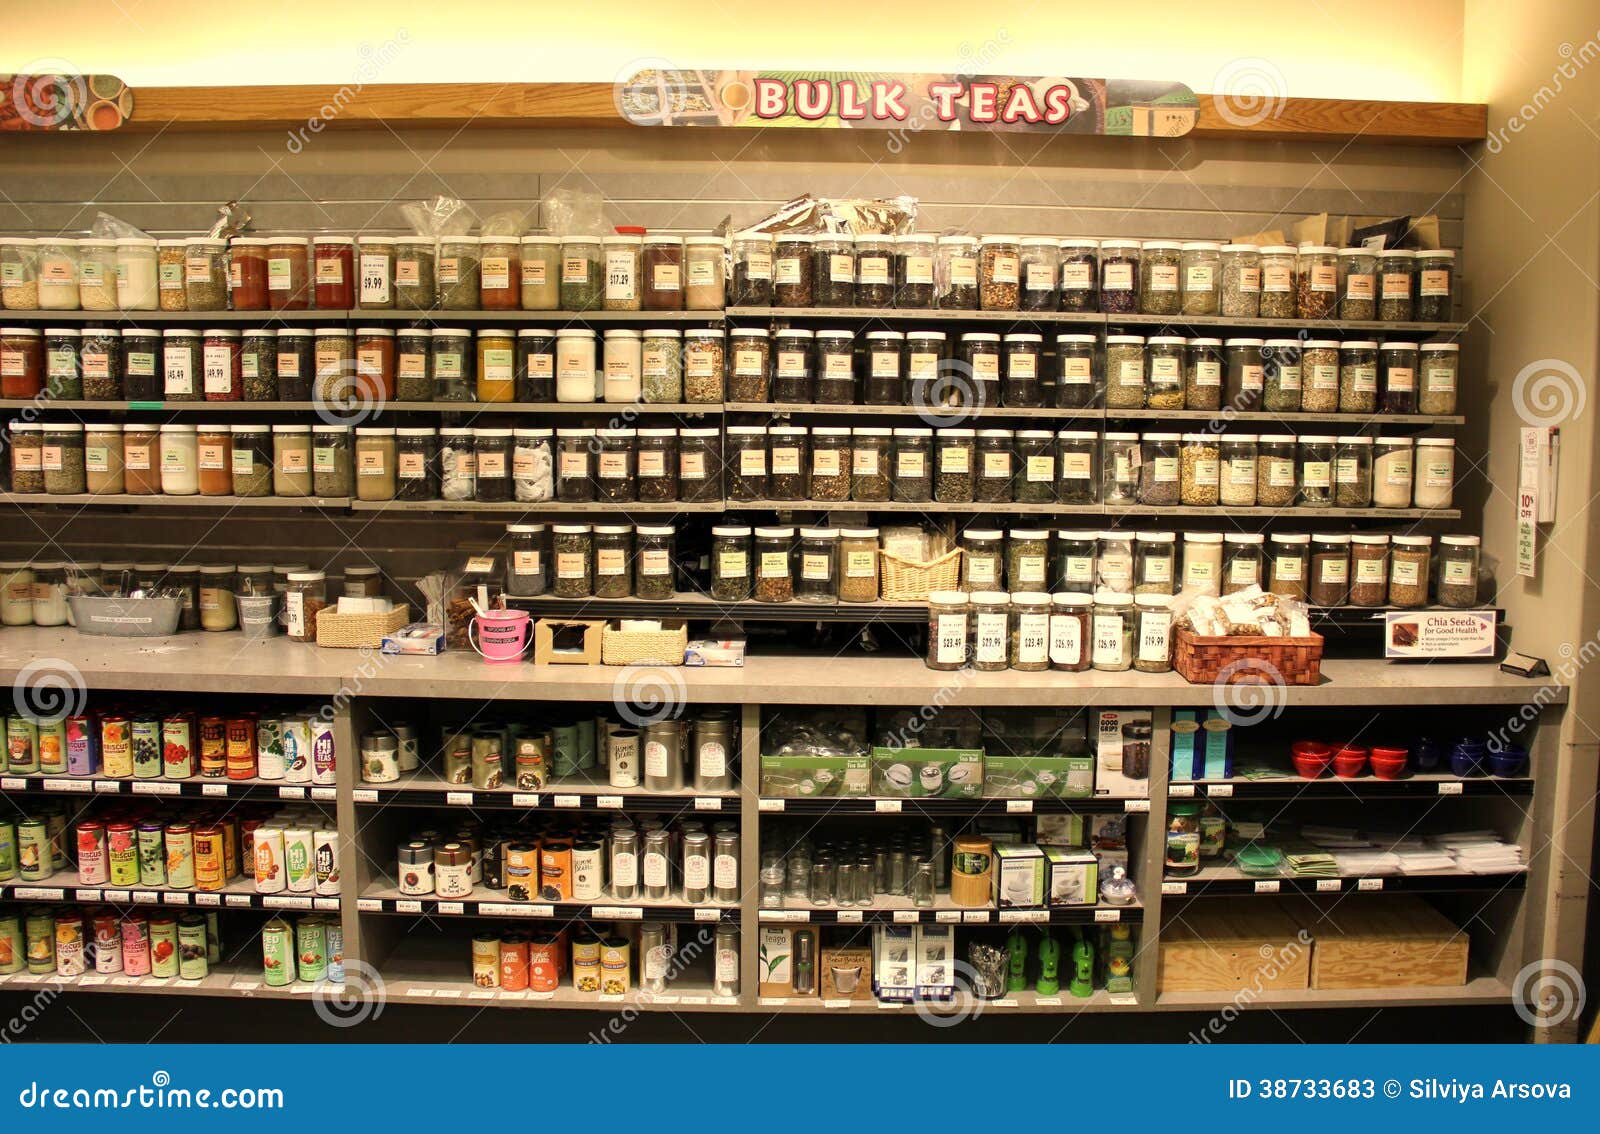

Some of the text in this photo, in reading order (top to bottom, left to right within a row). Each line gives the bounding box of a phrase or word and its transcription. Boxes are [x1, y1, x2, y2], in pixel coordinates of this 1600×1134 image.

[753, 77, 1073, 125] BULK TEAS
[364, 277, 382, 291] $9.99
[610, 273, 629, 285] $17.29
[1520, 509, 1532, 518] OFF
[1427, 617, 1476, 626] Chia Seeds
[1425, 627, 1435, 635] for
[1145, 635, 1164, 646] $19.99
[765, 935, 786, 945] Teago
